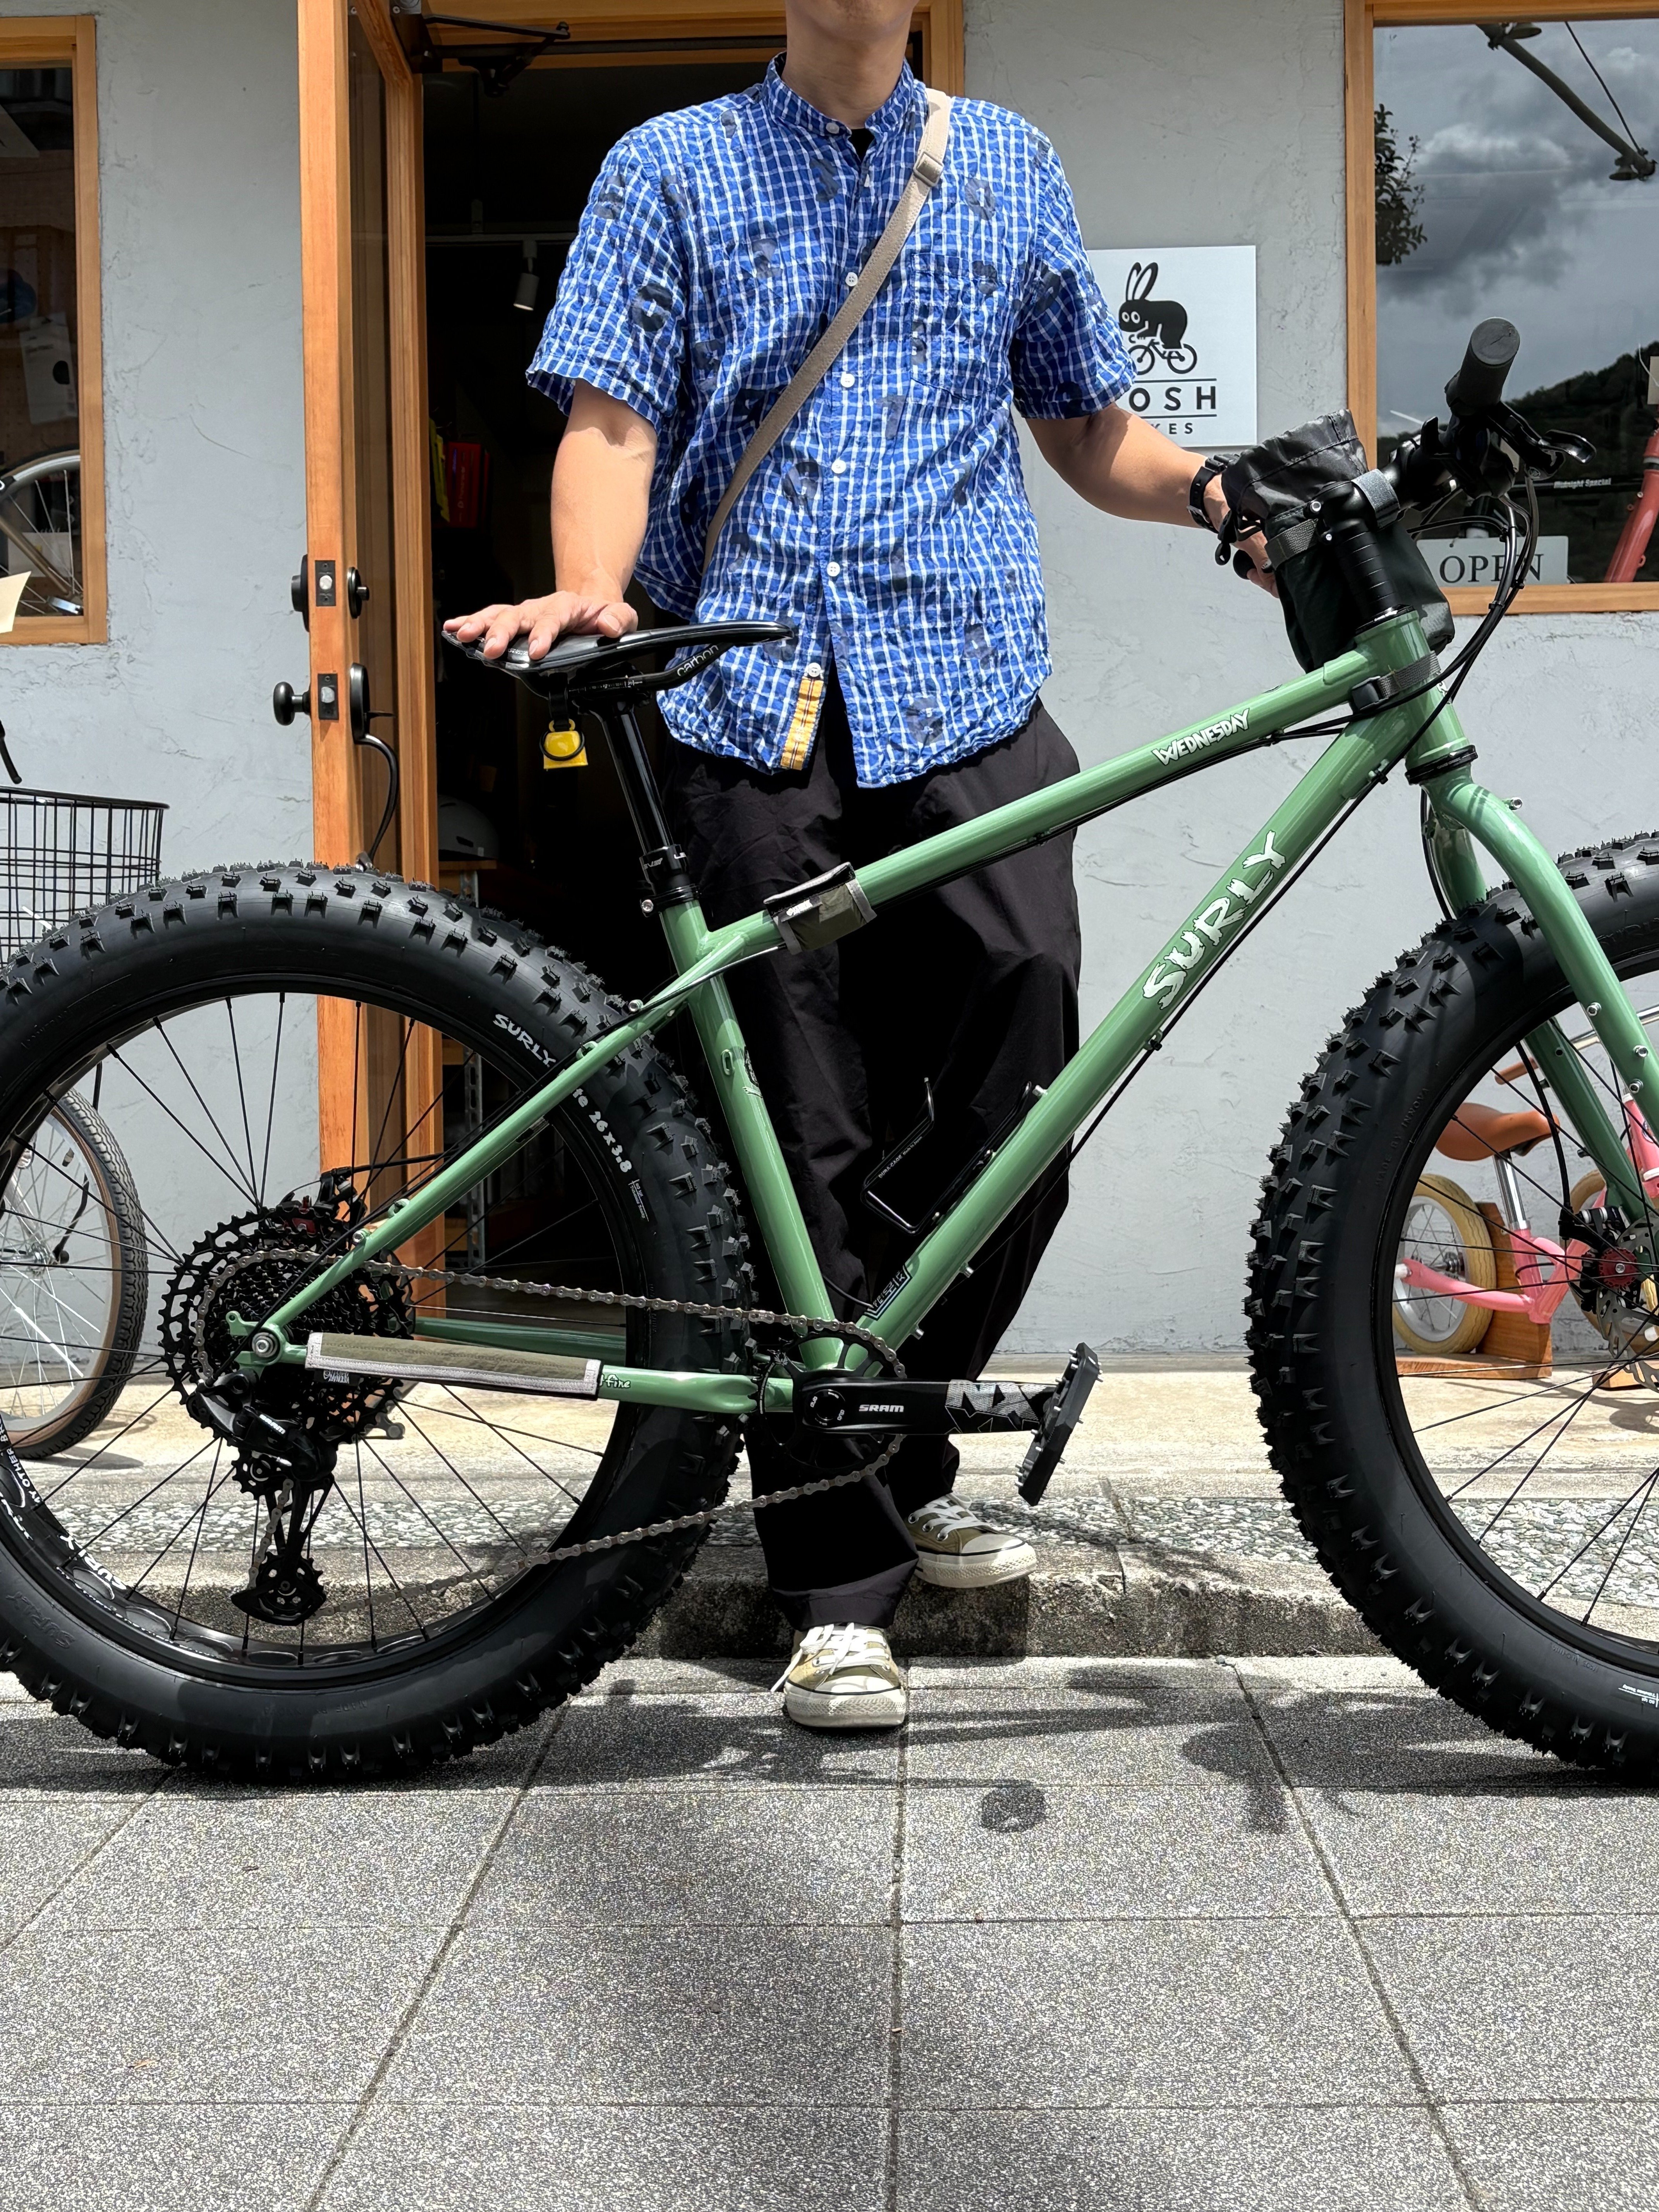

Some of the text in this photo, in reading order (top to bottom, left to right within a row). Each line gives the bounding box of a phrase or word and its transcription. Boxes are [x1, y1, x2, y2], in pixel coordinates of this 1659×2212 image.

[1129, 386, 1216, 412] OSH
[677, 644, 719, 677] carbon
[1152, 708, 1250, 766] WEDNESDAY
[1142, 830, 1286, 1010] SURLY
[493, 1014, 556, 1068] SURLY
[572, 1088, 588, 1107] te
[259, 1414, 286, 1435] SRAM
[859, 1404, 904, 1412] SRAM
[7, 1448, 31, 1488] OTHER
